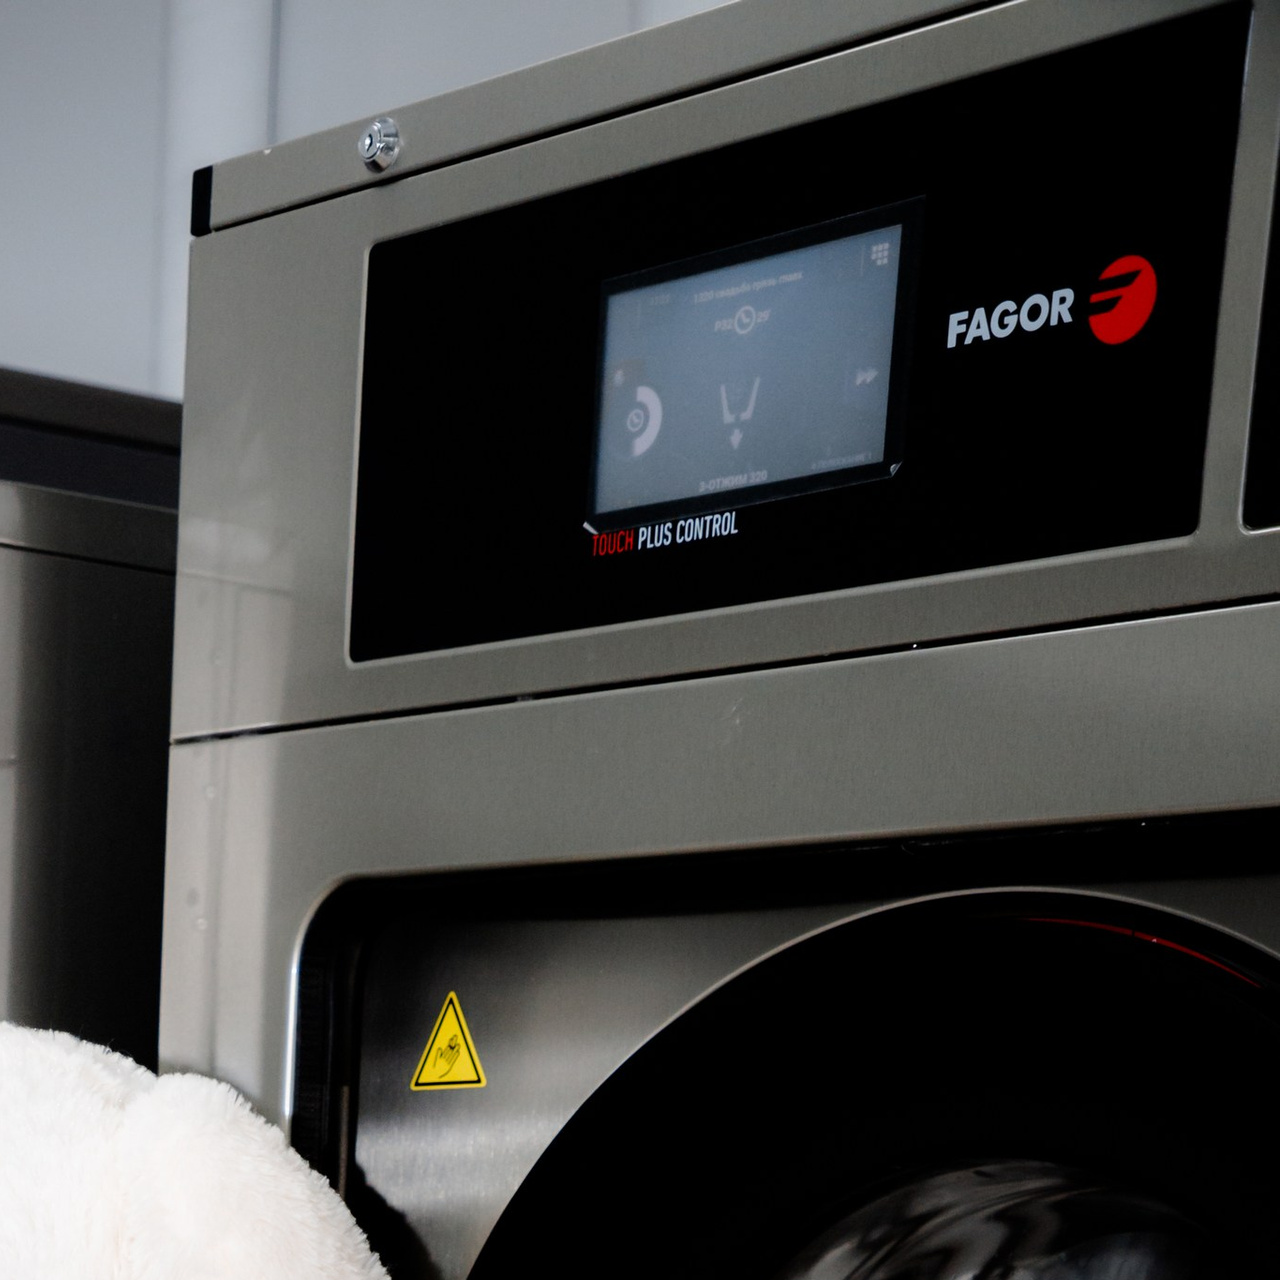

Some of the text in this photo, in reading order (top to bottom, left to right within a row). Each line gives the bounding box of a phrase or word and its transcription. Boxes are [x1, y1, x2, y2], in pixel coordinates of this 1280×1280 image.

[946, 287, 1074, 348] FAGOR
[591, 511, 739, 555] TOUCH PLUS CONTROL
